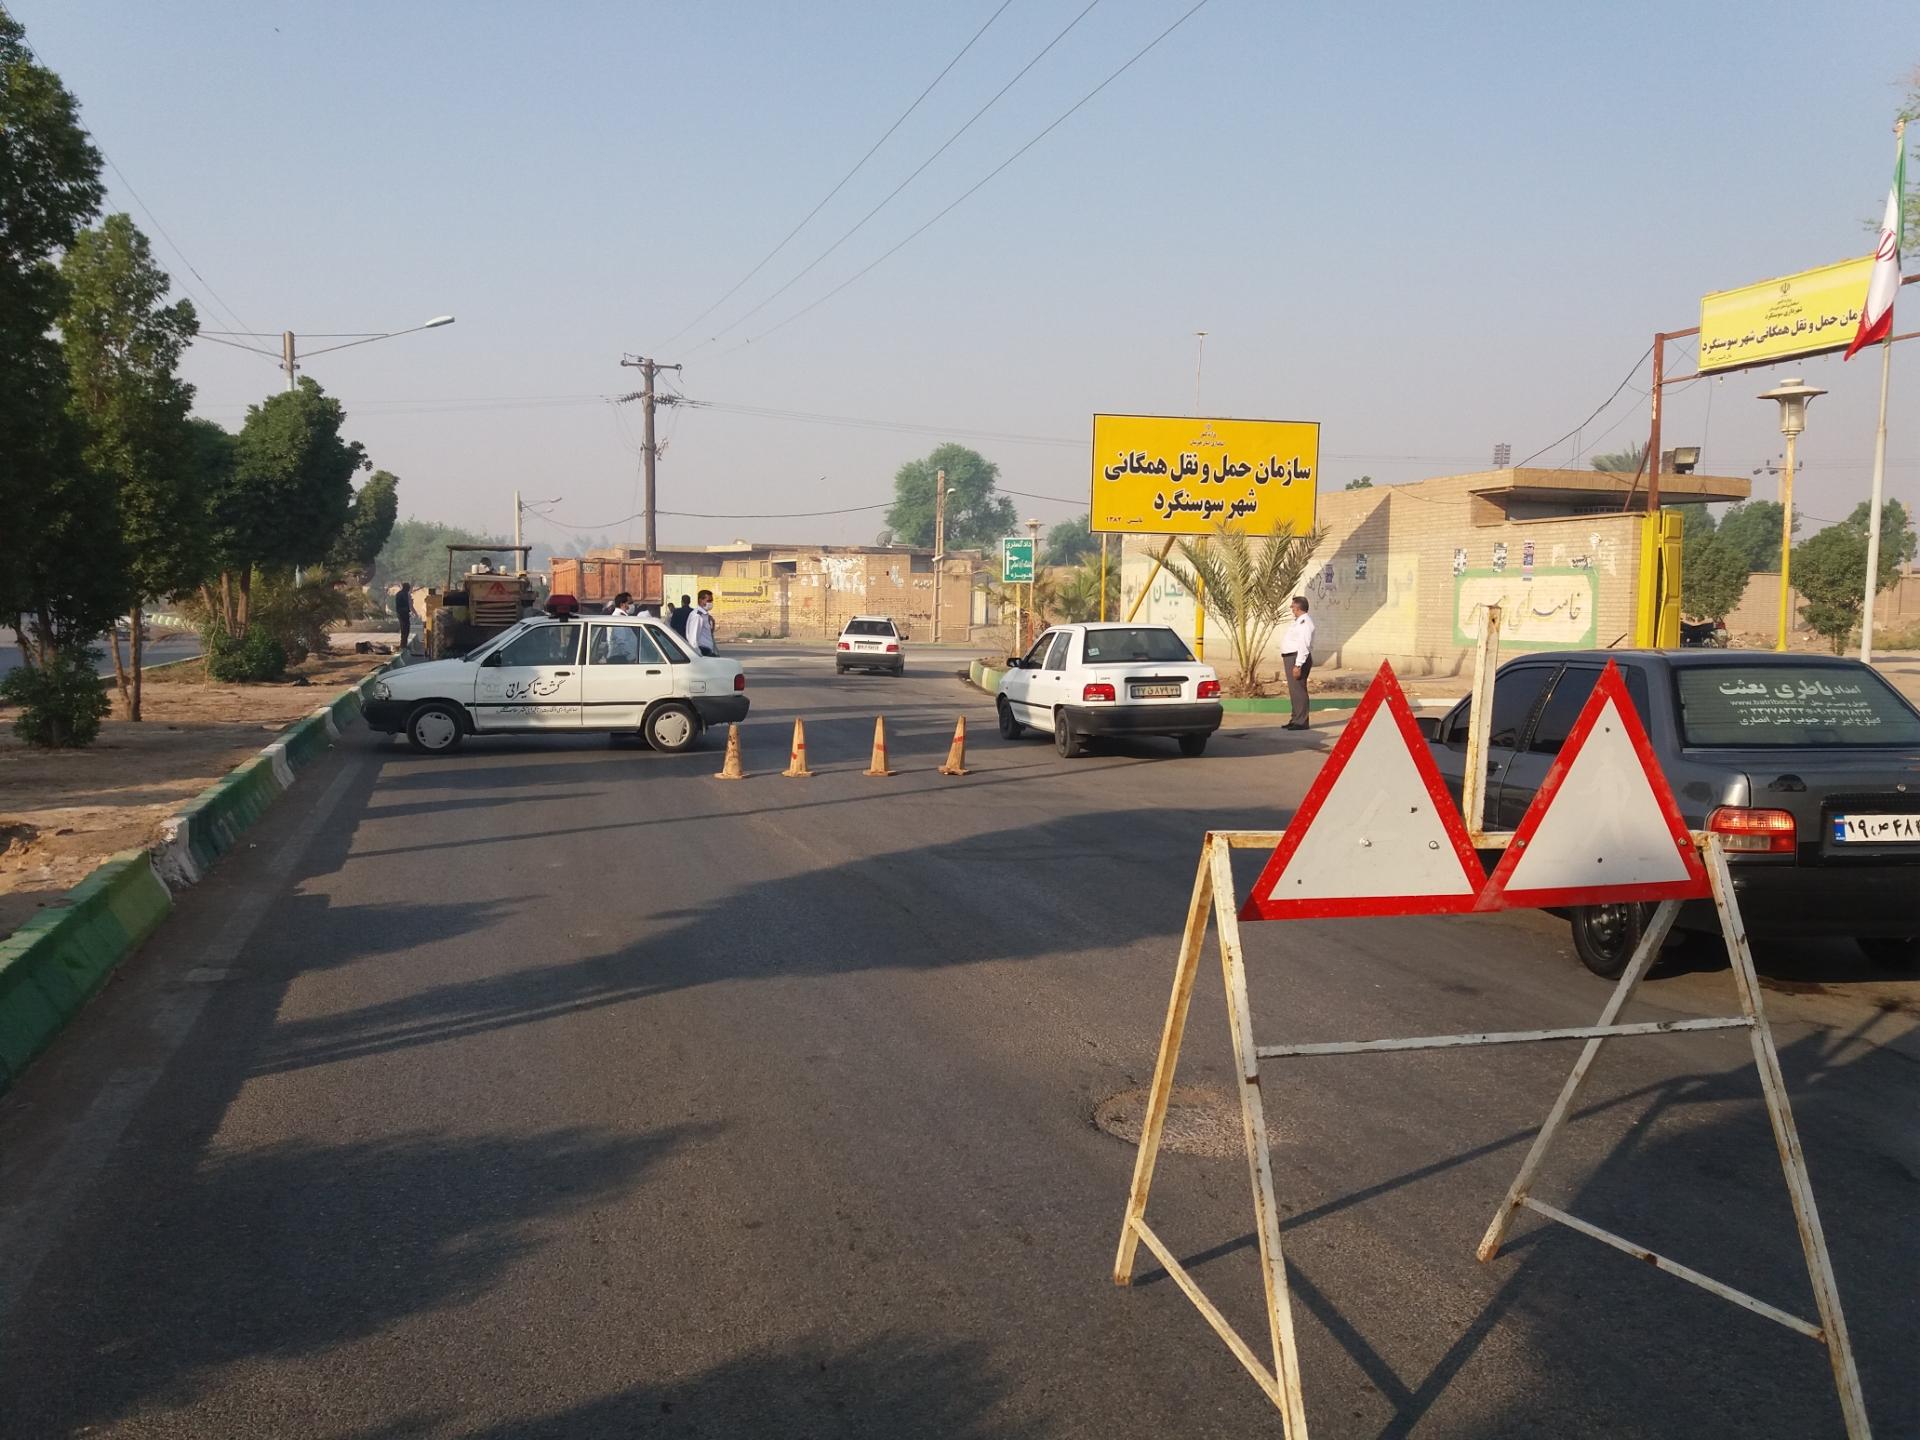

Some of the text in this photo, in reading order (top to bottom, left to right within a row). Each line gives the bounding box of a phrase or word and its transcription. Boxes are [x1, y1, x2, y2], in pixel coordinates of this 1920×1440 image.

[1791, 319, 1807, 336] نقل
[1808, 322, 1814, 333] و
[1815, 315, 1838, 331] حمل
[1738, 330, 1755, 347] شهر
[1756, 325, 1790, 344] همگانی
[1702, 338, 1738, 354] سوسنگرد
[1104, 450, 1311, 486] سازمان حمل و نقل همگانی
[1154, 488, 1257, 520] شهر سوسنگرد
[506, 677, 566, 701] گشت تاکسیرانی
[1719, 679, 1769, 698] بعثت
[1774, 680, 1836, 699] باطری
